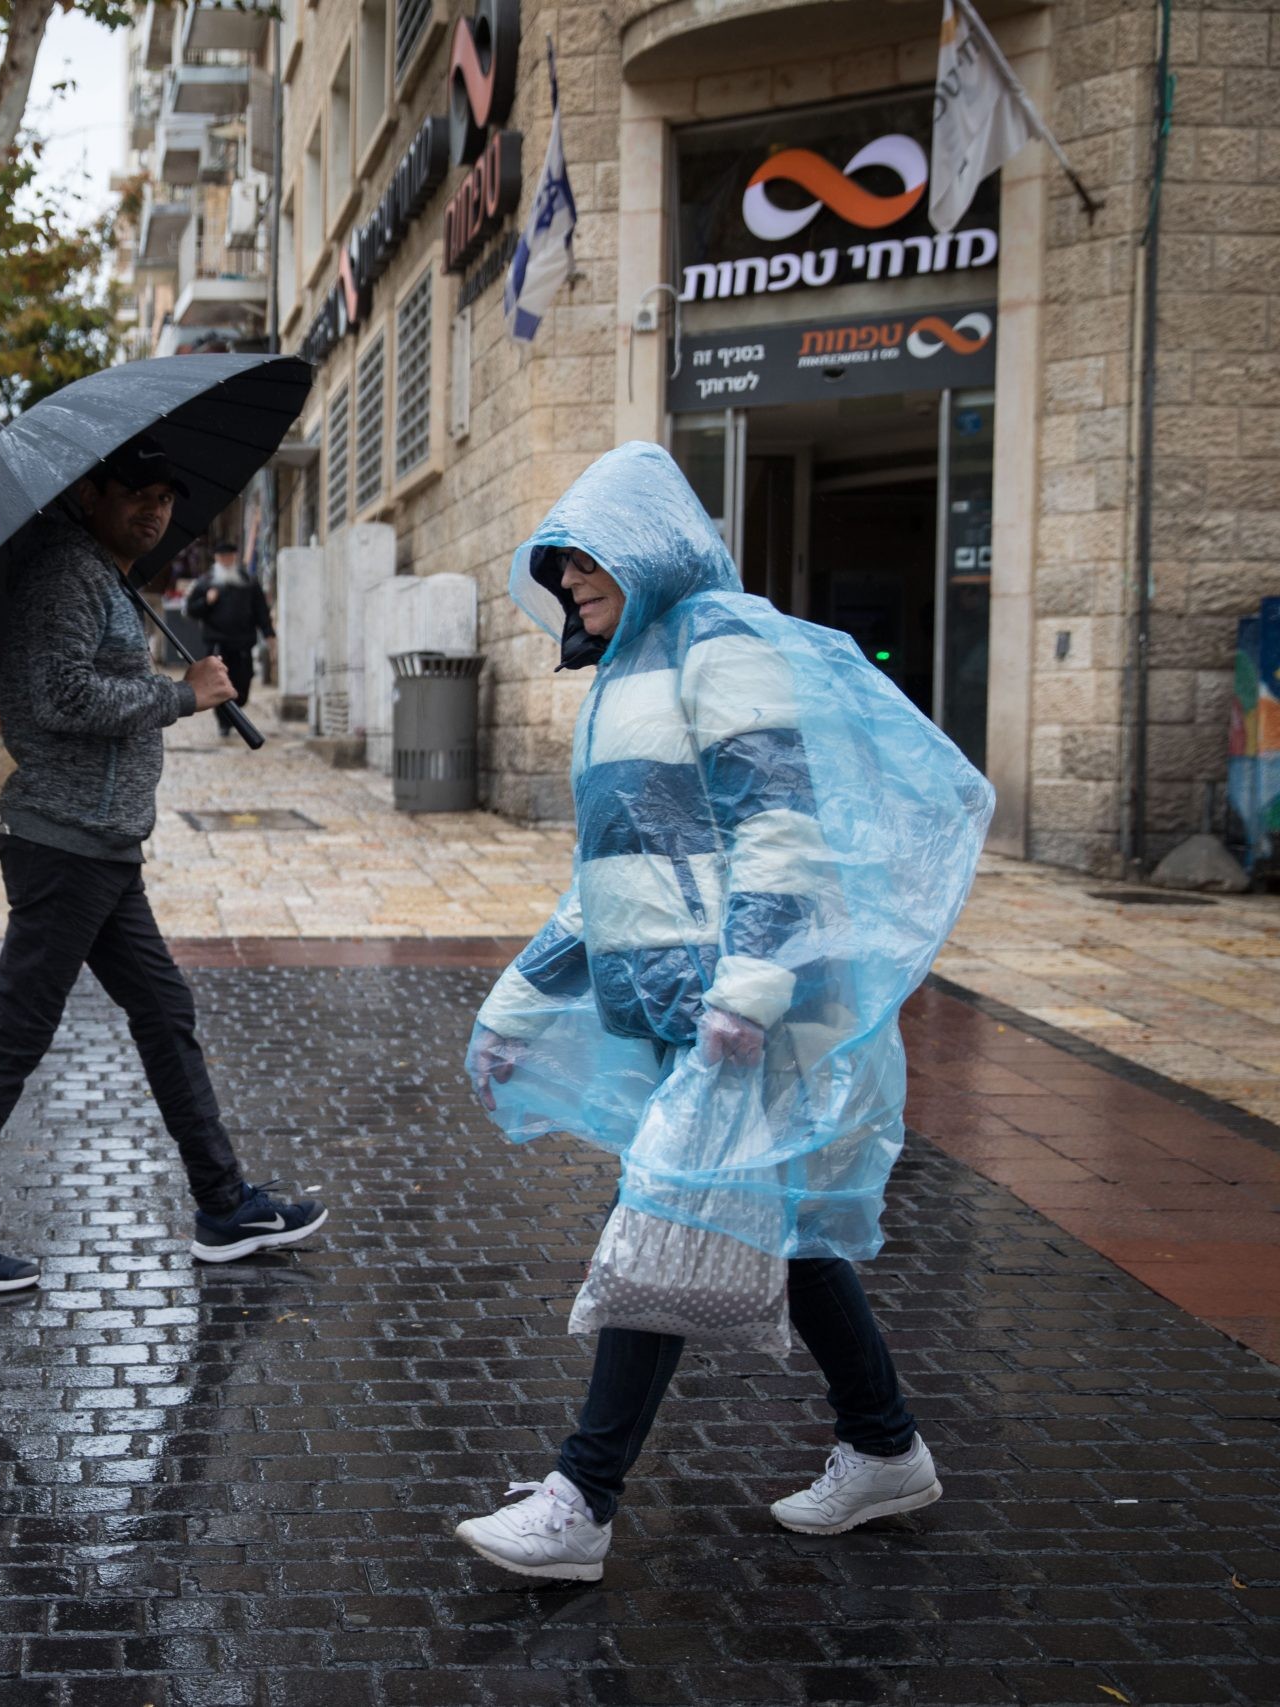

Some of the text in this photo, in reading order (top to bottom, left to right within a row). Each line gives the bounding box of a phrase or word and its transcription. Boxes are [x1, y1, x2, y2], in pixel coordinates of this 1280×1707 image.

[441, 131, 501, 275] טפחות
[677, 228, 998, 301] מזרחי טפחות
[800, 323, 904, 355] טפחות
[693, 344, 765, 368] בסניף זה
[696, 370, 760, 399] לשרותך
